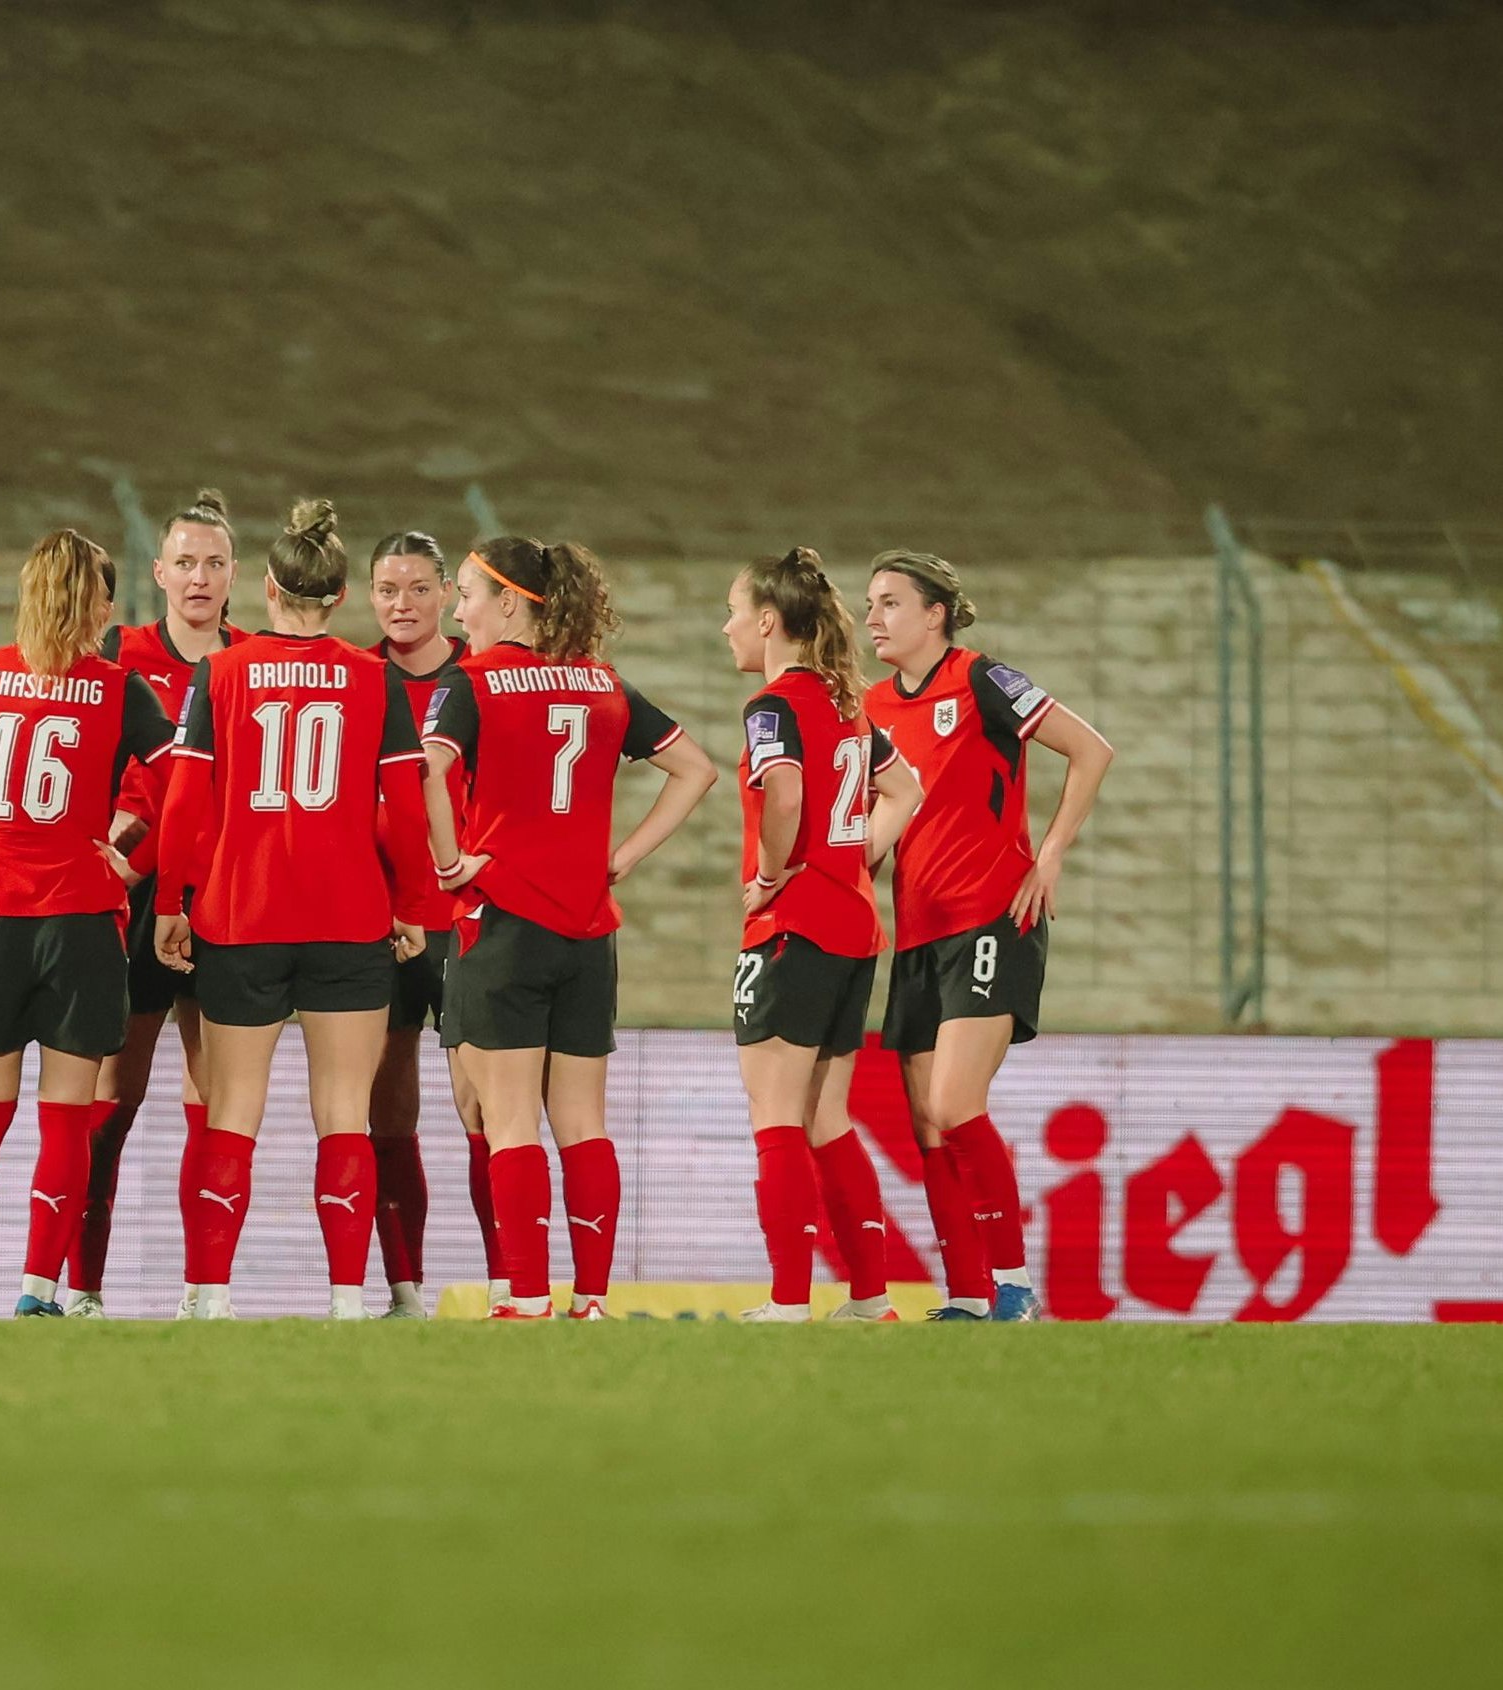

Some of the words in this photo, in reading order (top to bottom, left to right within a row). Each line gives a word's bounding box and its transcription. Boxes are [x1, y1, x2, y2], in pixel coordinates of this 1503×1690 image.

[248, 661, 348, 690] BRUNOLD
[484, 665, 614, 694] BRUNNTHALER
[249, 701, 344, 812] 10
[548, 704, 590, 814] 7
[733, 952, 764, 1004] 22
[972, 935, 998, 983] 8
[812, 1032, 1441, 1322] iegl
